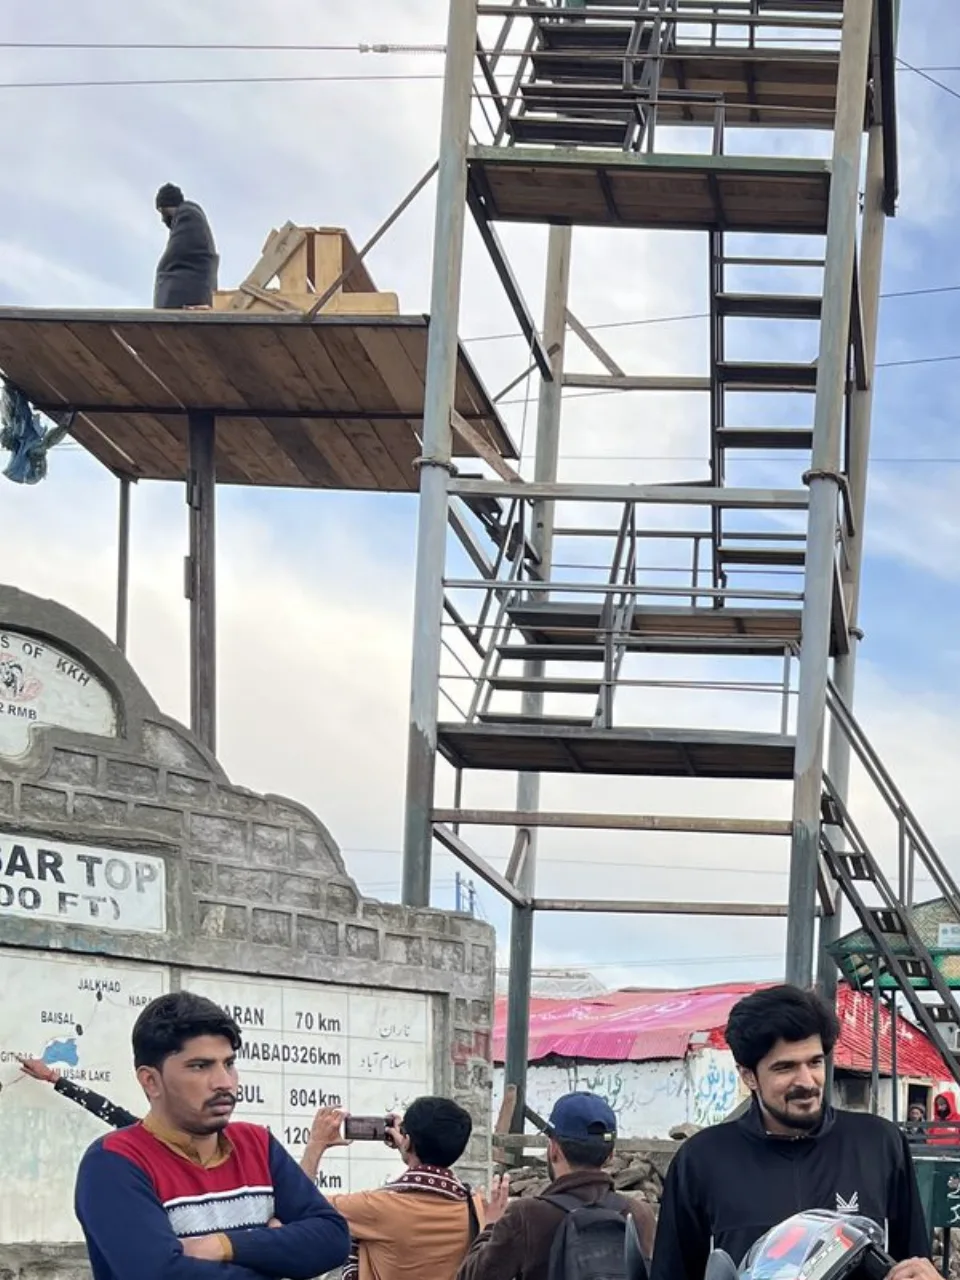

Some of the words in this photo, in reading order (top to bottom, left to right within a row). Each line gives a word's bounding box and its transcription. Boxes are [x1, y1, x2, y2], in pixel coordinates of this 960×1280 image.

[22, 642, 44, 659] OF
[56, 658, 90, 687] KKH
[8, 704, 37, 720] RMB
[77, 854, 159, 893] TOP
[78, 978, 121, 993] JALKHAD
[41, 1011, 75, 1025] BAISAL
[220, 1004, 264, 1026] ARAN
[295, 1011, 313, 1029] 70
[318, 1013, 341, 1032] km
[238, 1041, 290, 1062] MABAD
[89, 1070, 111, 1082] LAKE
[236, 1084, 264, 1103] BUL
